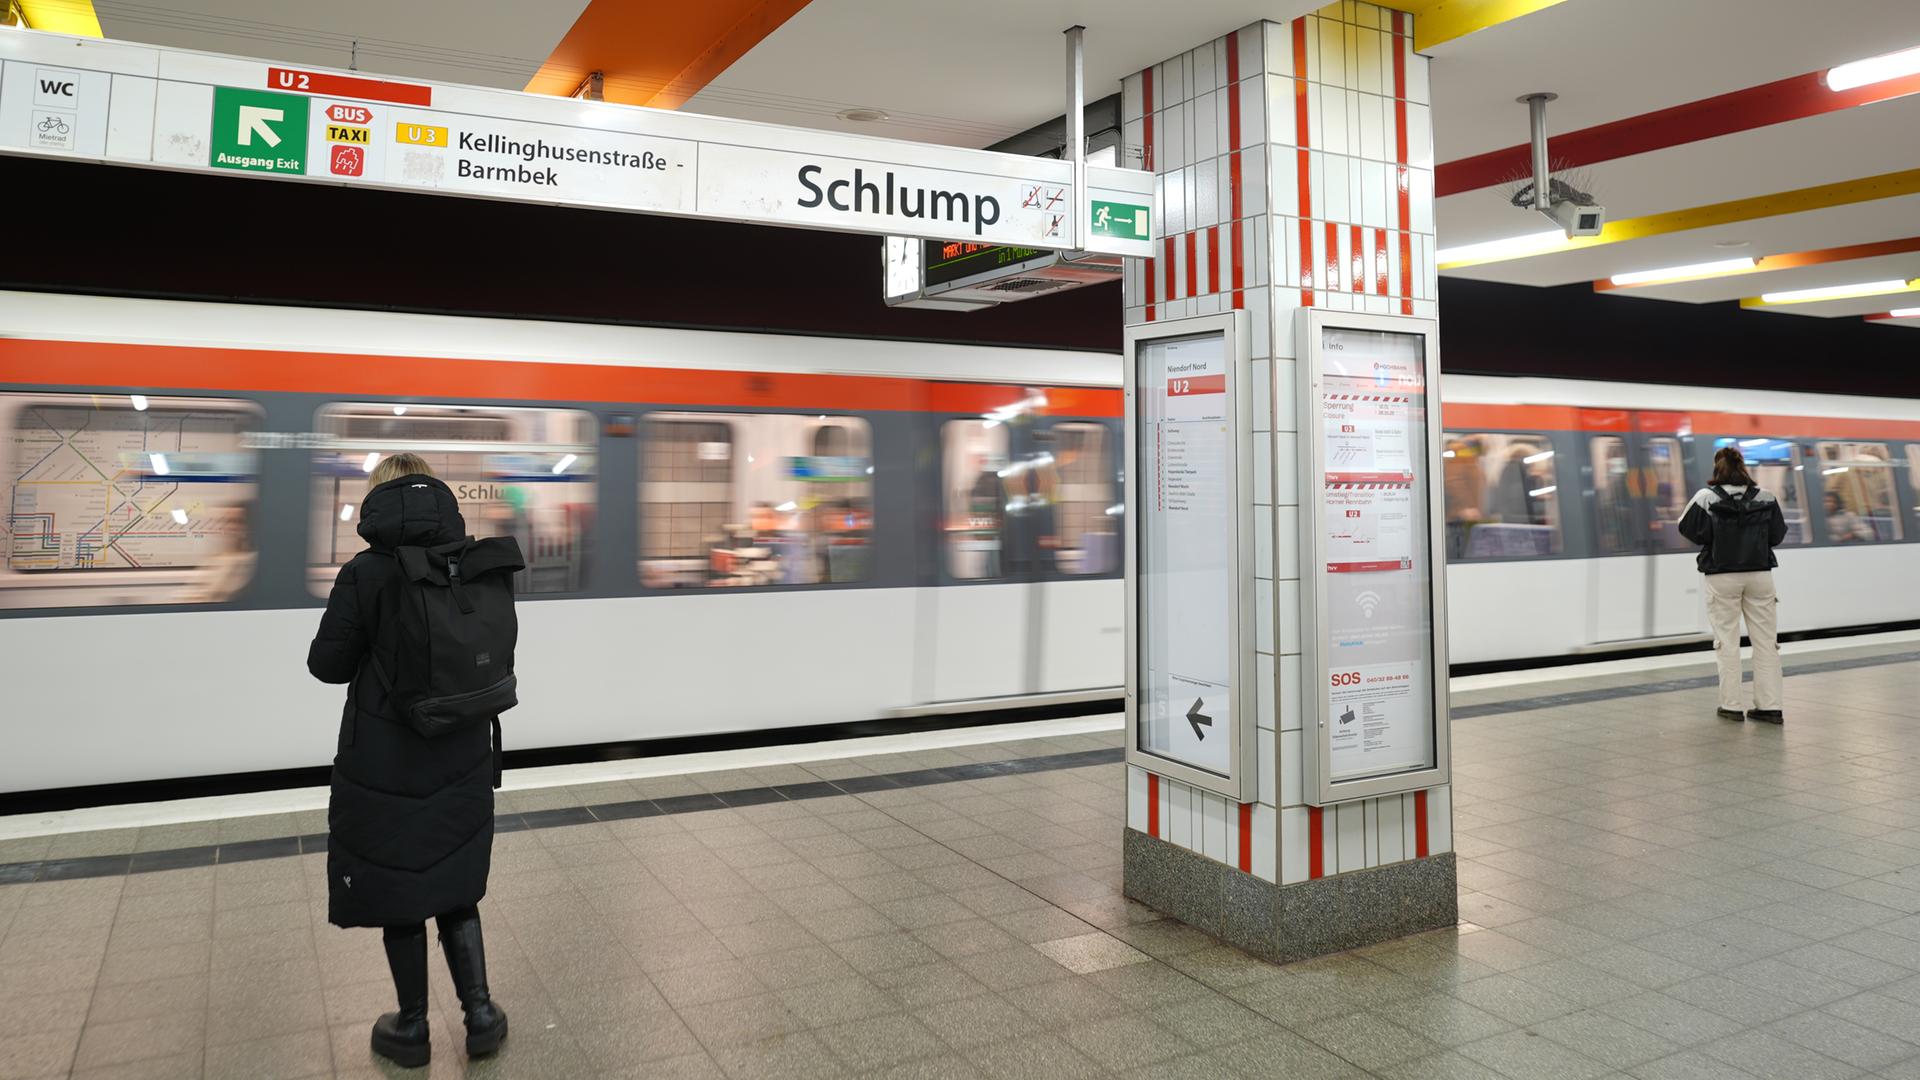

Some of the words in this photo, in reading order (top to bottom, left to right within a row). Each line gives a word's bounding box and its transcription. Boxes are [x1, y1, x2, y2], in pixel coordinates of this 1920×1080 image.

[40, 79, 74, 97] WC
[333, 106, 366, 122] BUS
[329, 127, 367, 142] TAXI
[459, 131, 667, 171] Kellinghusenstraße
[217, 152, 274, 170] Ausgang
[276, 158, 300, 170] Exit
[457, 159, 558, 186] Barmbek
[797, 164, 1001, 235] Schlump
[1328, 342, 1344, 351] Info
[1167, 363, 1192, 373] Niendorf
[1192, 362, 1207, 371] Nord
[1323, 401, 1354, 413] Sperrung
[457, 484, 505, 500] Schlu
[1331, 671, 1361, 687] SOS
